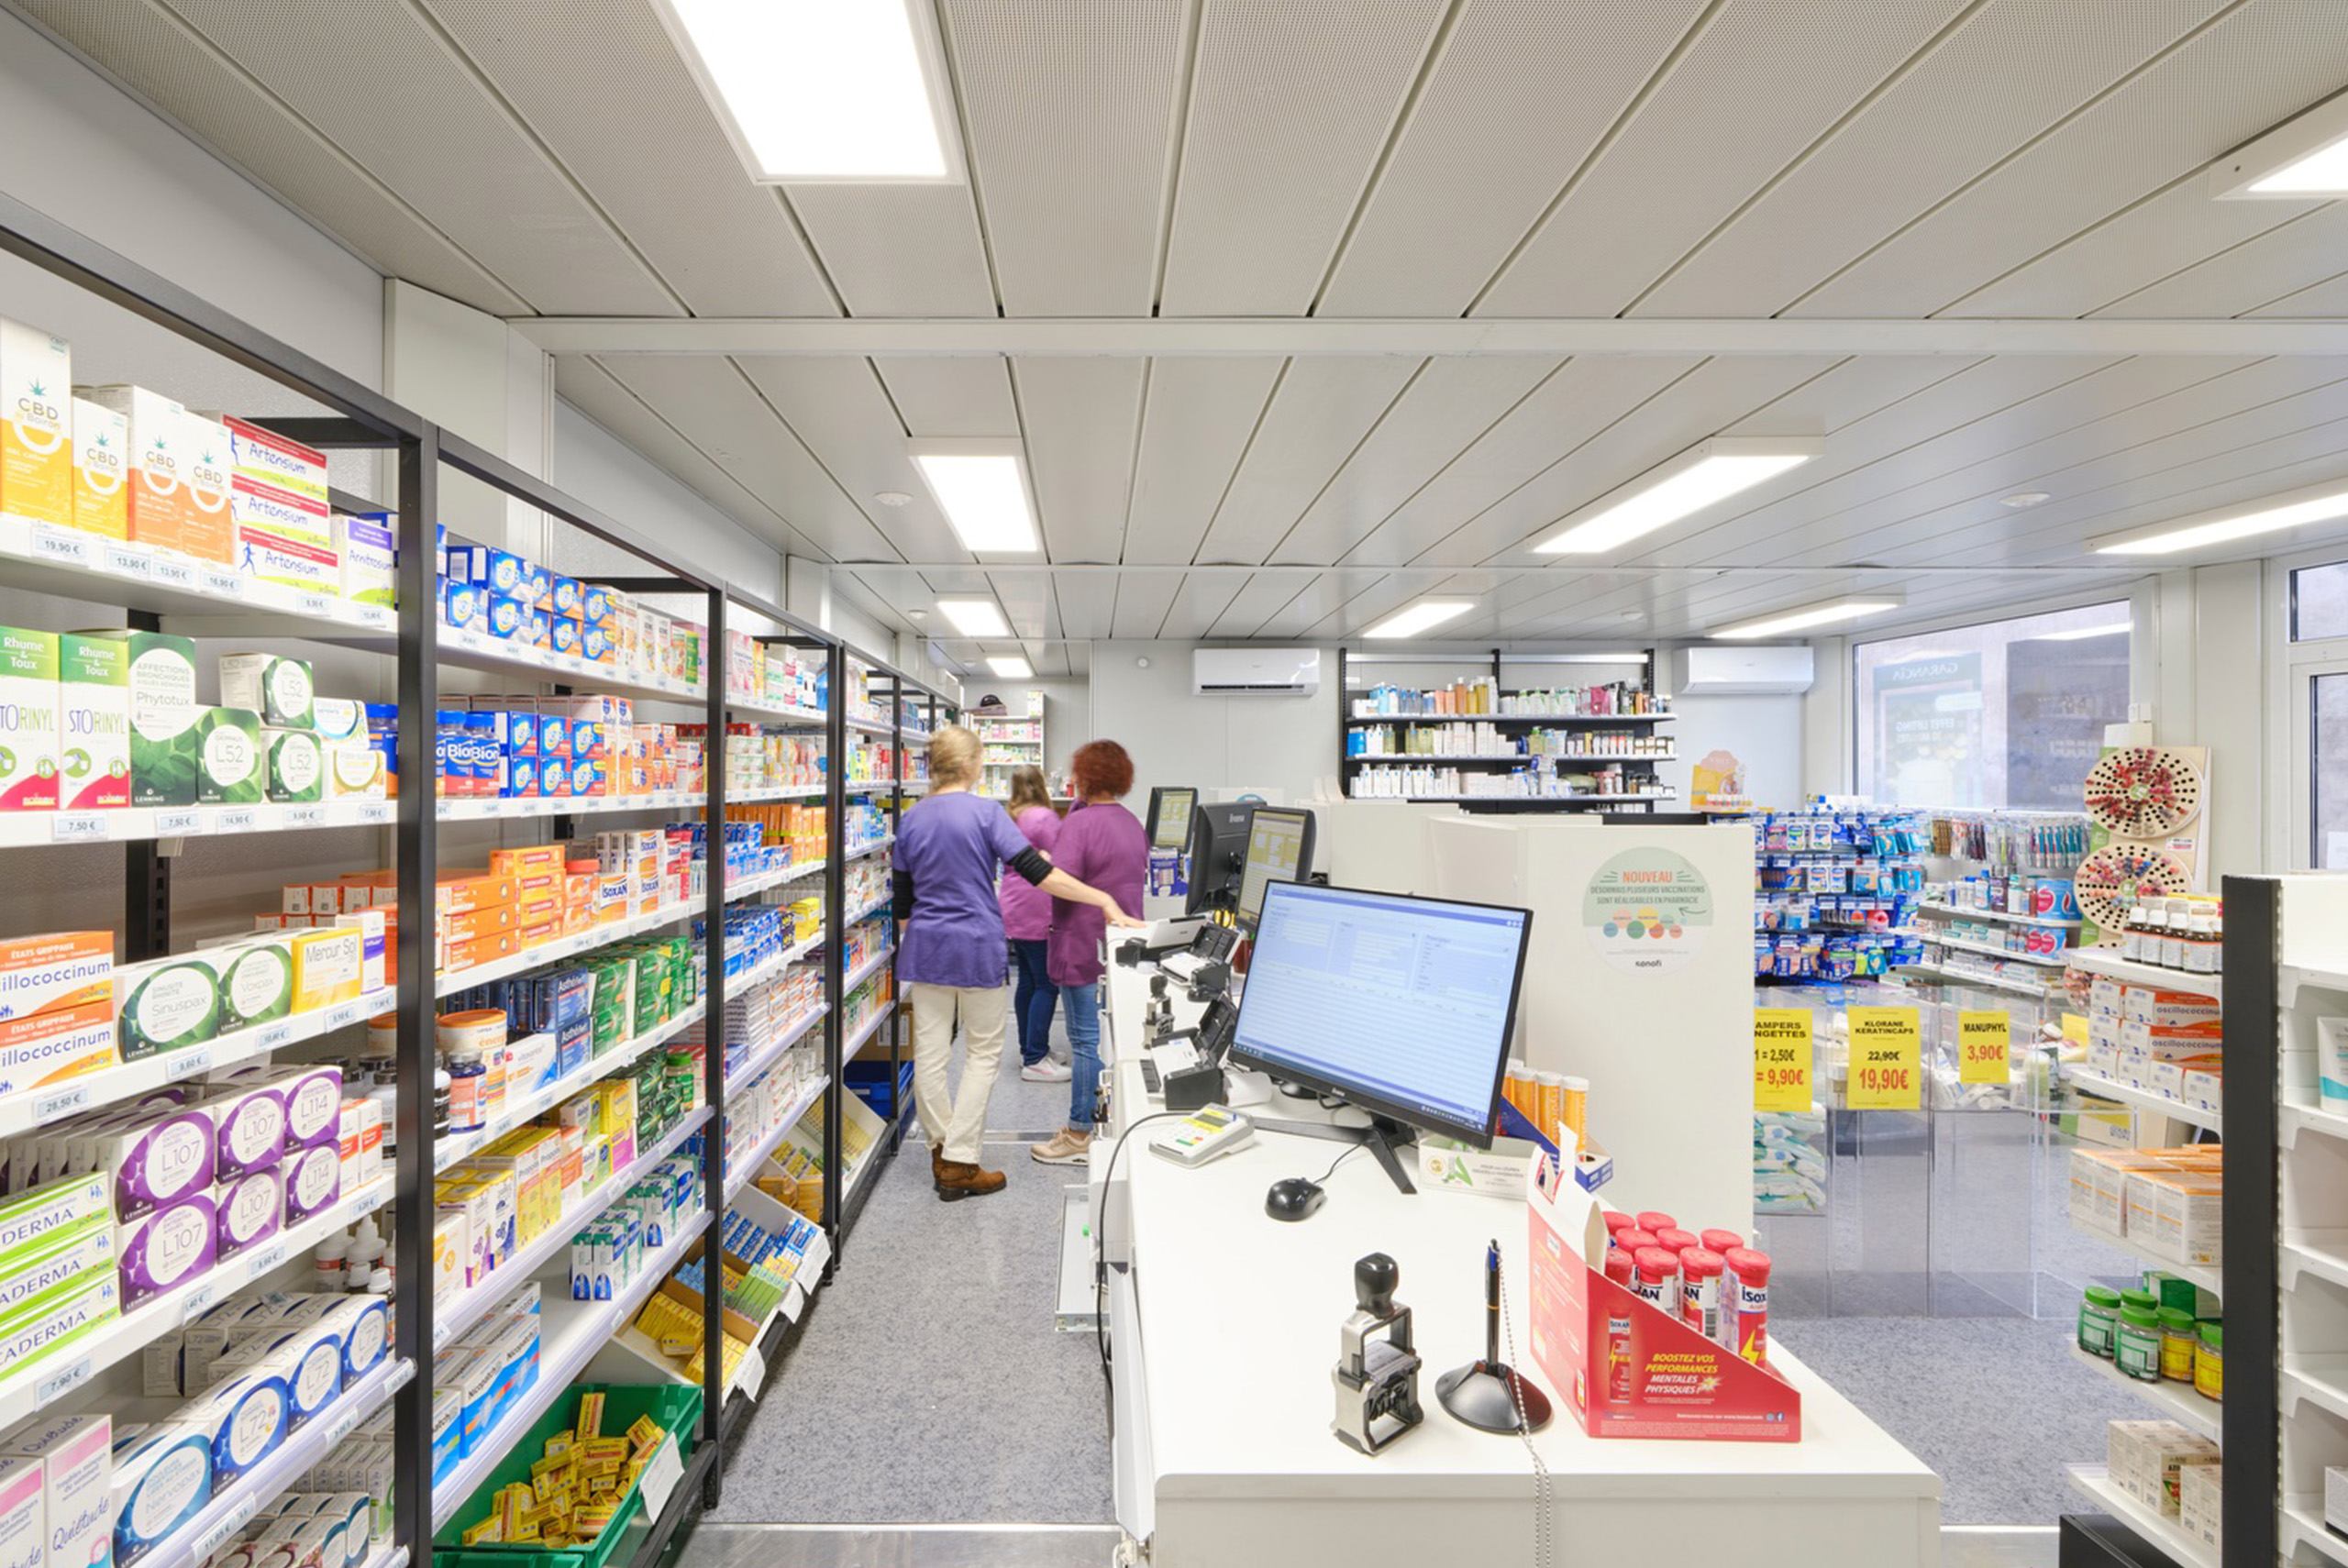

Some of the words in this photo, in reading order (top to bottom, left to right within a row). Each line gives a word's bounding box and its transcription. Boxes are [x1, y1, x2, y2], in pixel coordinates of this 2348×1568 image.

[18, 397, 59, 421] CBD
[86, 448, 118, 467] CBD
[146, 451, 175, 469] CBD
[249, 443, 306, 475] Artensium
[194, 467, 223, 484] CBD
[248, 497, 308, 525] Artensium
[265, 550, 320, 576] Artensium
[4, 637, 44, 653] Rhume
[79, 646, 116, 660] Rhume
[10, 656, 37, 670] Toux
[84, 665, 109, 677] Toux
[282, 679, 304, 698] L52
[136, 690, 190, 707] Phytotux
[0, 704, 54, 732] TORINYL
[69, 709, 125, 734] STORINYL
[216, 745, 244, 764] L52
[448, 744, 473, 757] Bio
[289, 754, 312, 770] L52
[1623, 870, 1673, 883] NOUVEAU
[0, 961, 110, 992] illococcinum
[151, 996, 208, 1015] Sinuspax
[1755, 1021, 1801, 1030] AMPERS
[1755, 1030, 1806, 1038] NGETTES
[1963, 1022, 2007, 1032] MANUPHYL
[0, 1030, 111, 1067] illococcinum
[1770, 1049, 1795, 1063] 2,50€
[1967, 1044, 2003, 1063] 3,90€
[1767, 1069, 1803, 1088] 9,90€
[1859, 1068, 1909, 1093] 19,90€
[301, 1096, 328, 1118] L114
[243, 1114, 275, 1141] L107
[161, 1140, 201, 1172] L107
[305, 1165, 329, 1187] L114
[241, 1189, 271, 1219] L107
[2, 1209, 73, 1245] DERMA
[162, 1222, 203, 1258] L107
[0, 1260, 81, 1305] ADERMA
[0, 1311, 87, 1367] ADERMA
[1653, 1353, 1695, 1363] BOOSTEZ
[1697, 1354, 1715, 1363] VOS
[306, 1360, 329, 1389] L72
[1645, 1364, 1718, 1373] PERFORMANCES
[1651, 1375, 1698, 1384] MENTALES
[1645, 1385, 1695, 1394] PHYSIQUES
[239, 1411, 266, 1442] L72
[146, 1470, 202, 1512] Nervopax
